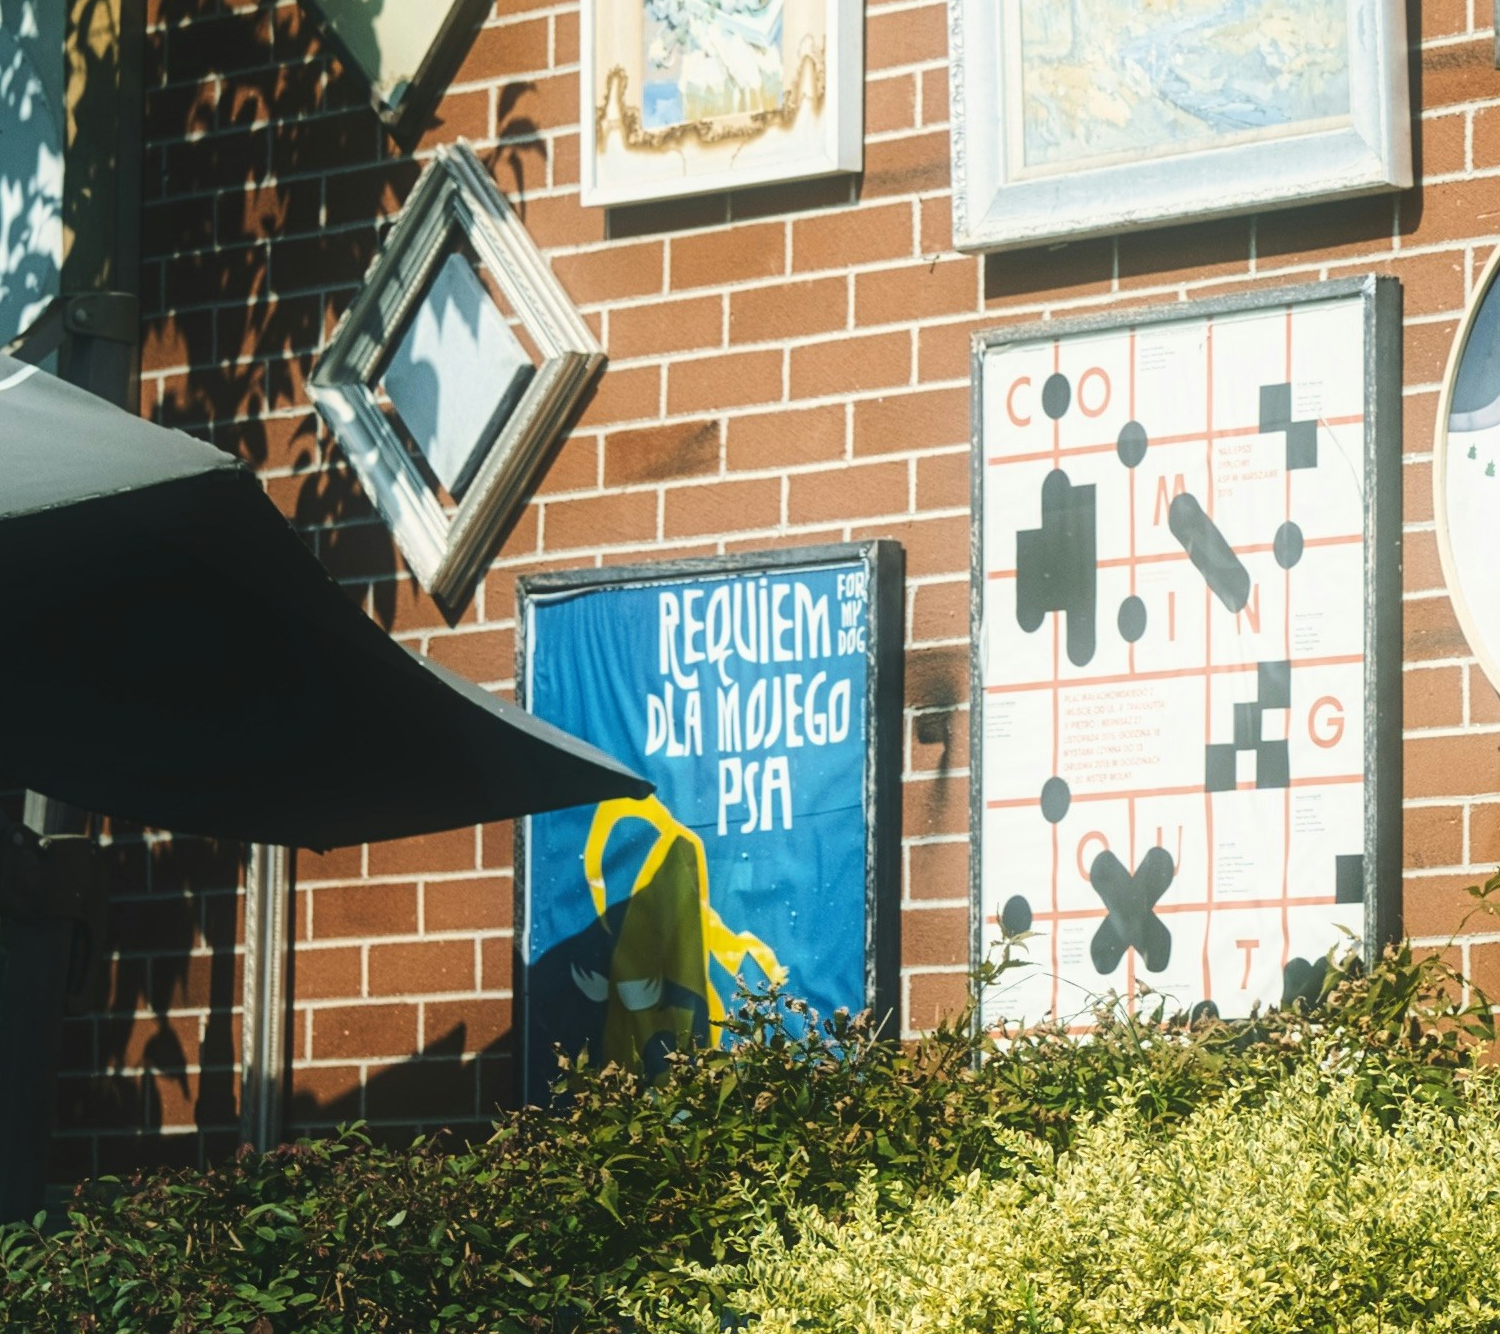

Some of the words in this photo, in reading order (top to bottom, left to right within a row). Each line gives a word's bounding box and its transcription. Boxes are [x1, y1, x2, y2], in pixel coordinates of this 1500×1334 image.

[837, 572, 866, 600] FOR
[841, 599, 862, 628] MY
[838, 626, 866, 656] DOG
[646, 681, 702, 757] DLA
[716, 671, 851, 752] MOJEGO
[717, 756, 792, 836] PSA
